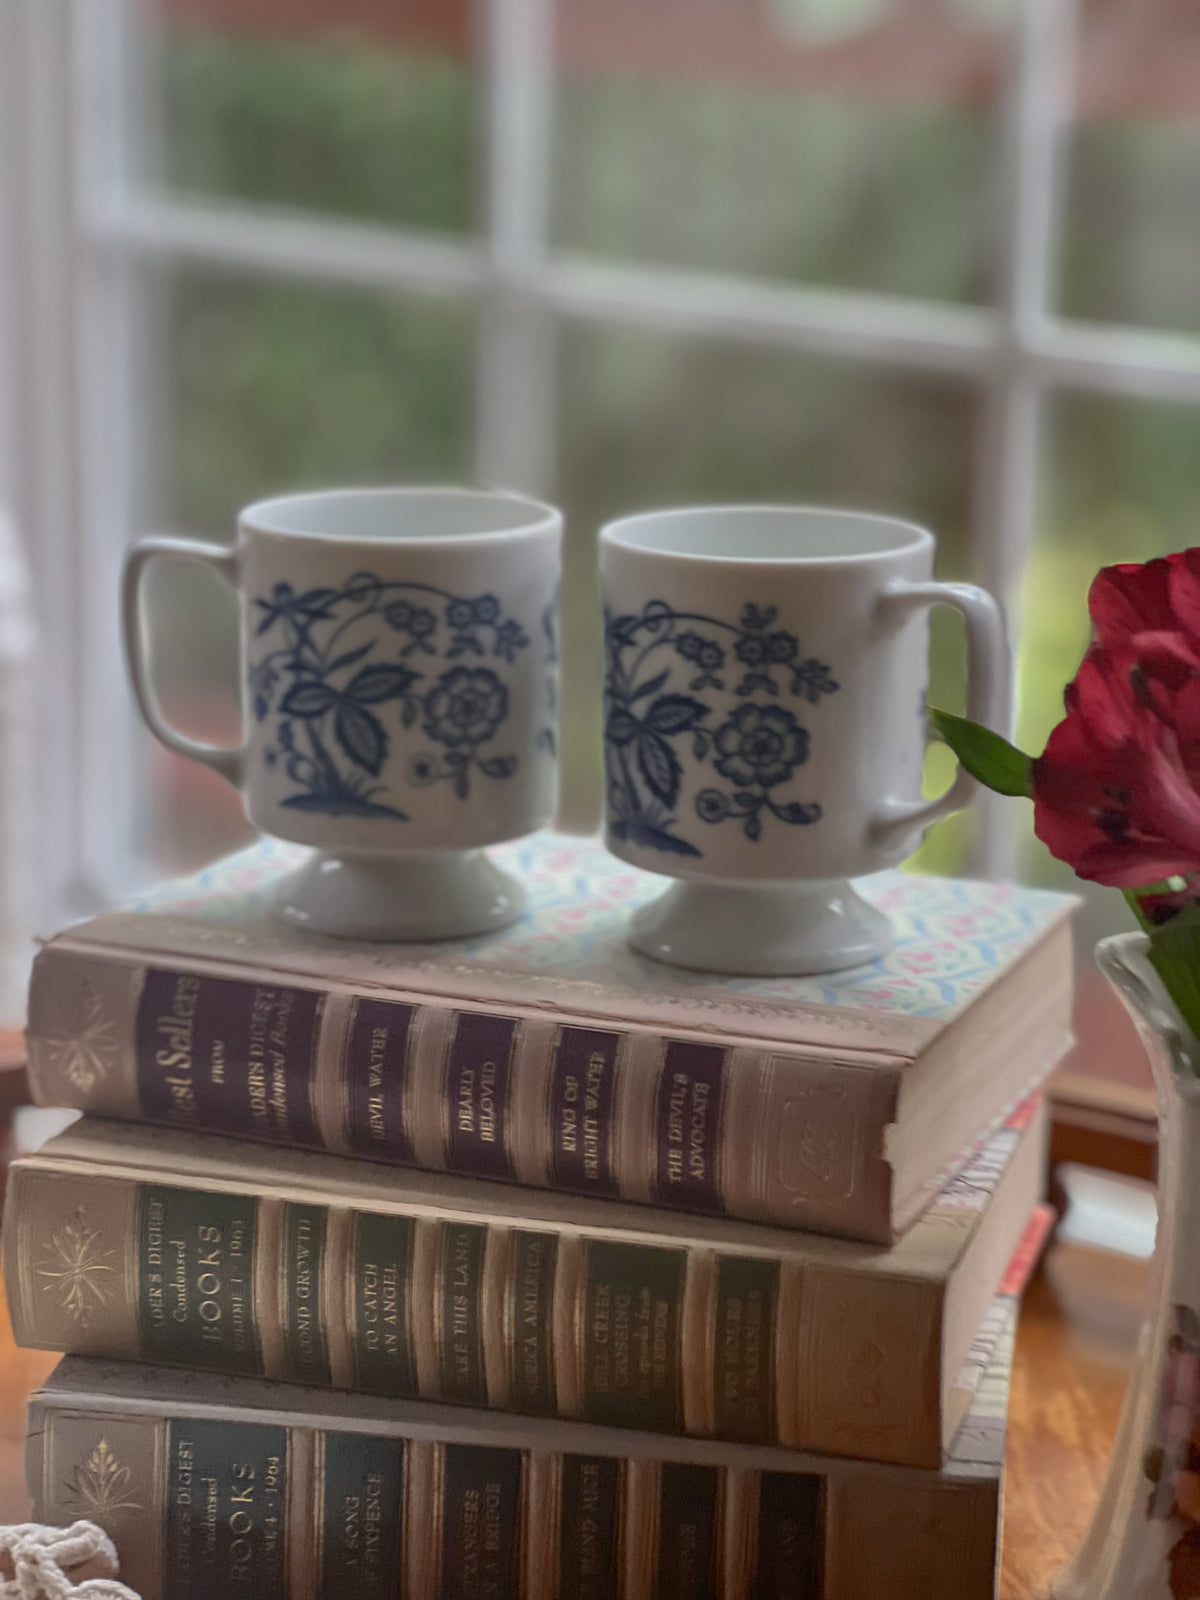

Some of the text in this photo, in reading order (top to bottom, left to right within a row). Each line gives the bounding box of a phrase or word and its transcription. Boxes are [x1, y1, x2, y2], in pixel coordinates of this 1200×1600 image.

[155, 977, 202, 1068] Sellers
[212, 1040, 224, 1084] FROM
[249, 988, 274, 1130] ADER'S DIGEST
[369, 1027, 389, 1139] DEVIL WATER
[459, 1066, 475, 1132] DEARLY
[480, 1061, 497, 1142] BELOVED
[562, 1075, 578, 1152] RING OF
[584, 1052, 605, 1178] BRIGHT WATER
[669, 1074, 687, 1183] THE DEVIL'S
[692, 1082, 709, 1180] ADVOCATE
[148, 1197, 163, 1265] DIGEST
[296, 1218, 311, 1299] GROWTH
[454, 1233, 470, 1286] LAND
[170, 1240, 187, 1322] Condensed
[197, 1225, 222, 1342] BOOKS
[364, 1263, 378, 1351] TO CATCH
[383, 1263, 398, 1355] AN ANGEL
[454, 1294, 468, 1336] THIS
[525, 1241, 541, 1327] AMERICA
[595, 1282, 611, 1343] CREEK
[614, 1294, 631, 1387] CROSSING
[178, 1439, 194, 1505] DIGEST
[264, 1455, 279, 1493] 1964
[345, 1496, 359, 1549] SONG
[365, 1472, 381, 1564] SIXPENCE
[486, 1482, 501, 1551] BRIDGE
